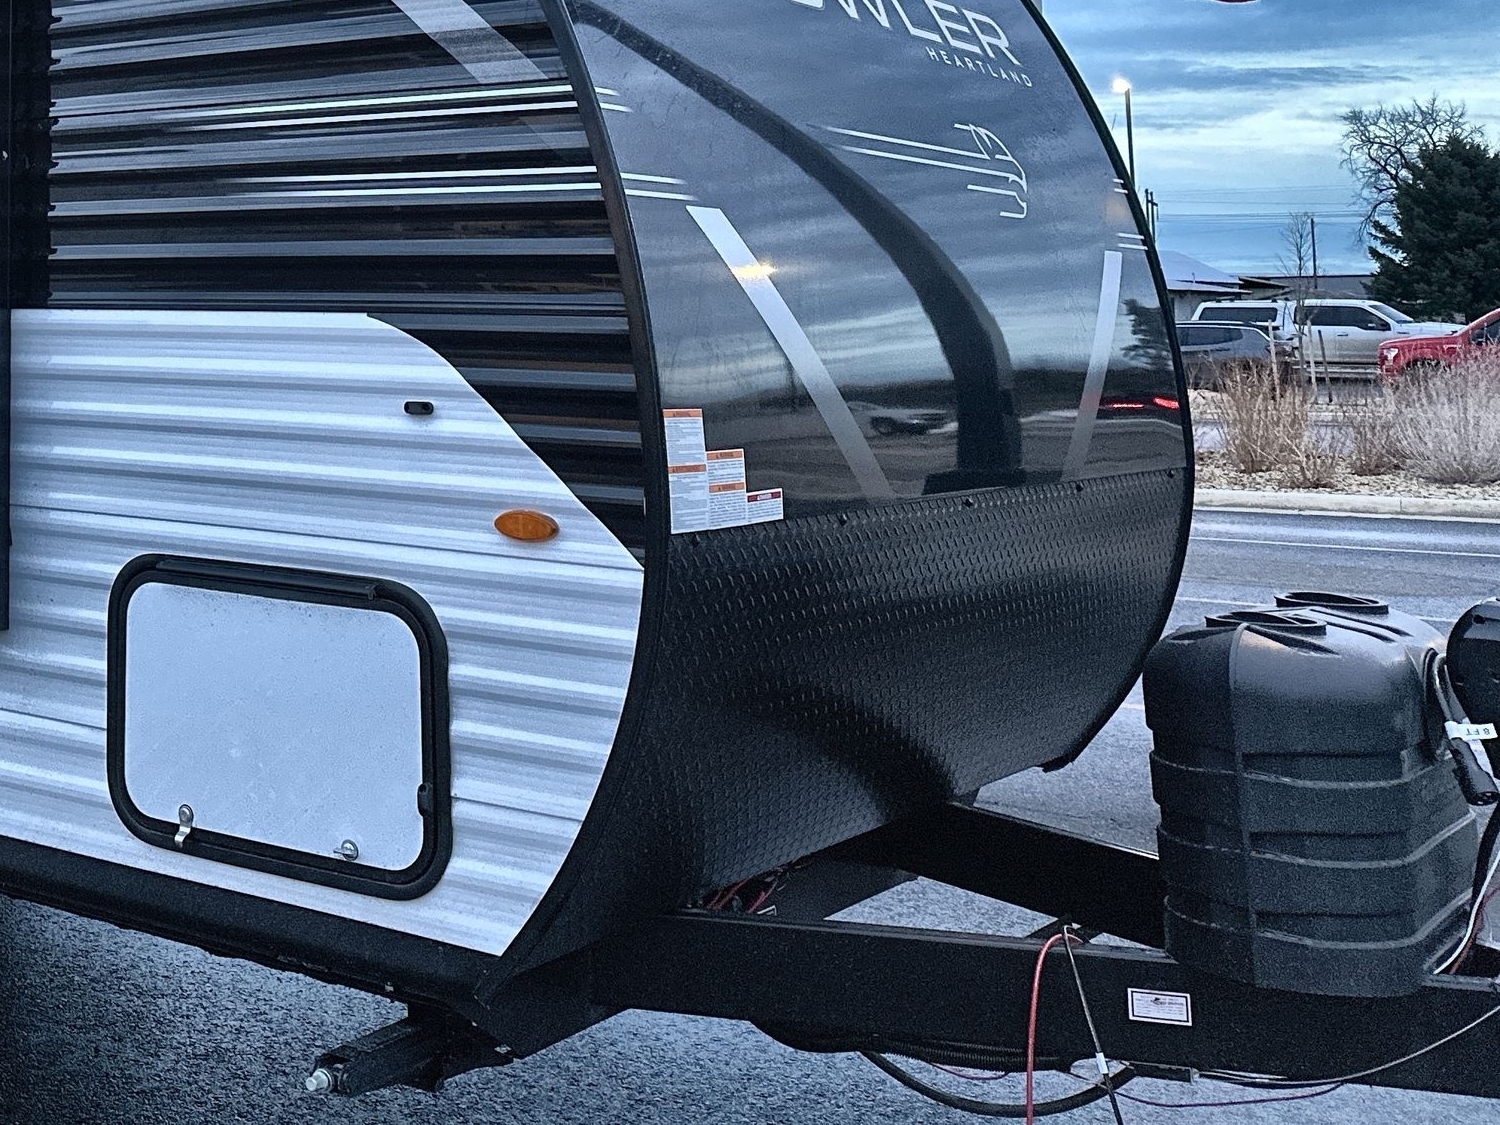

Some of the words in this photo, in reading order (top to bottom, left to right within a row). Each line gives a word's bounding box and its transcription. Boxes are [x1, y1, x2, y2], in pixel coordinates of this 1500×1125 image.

[925, 45, 1033, 88] HEARTLAND
[1466, 728, 1480, 736] FT
[1482, 727, 1491, 736] 8
